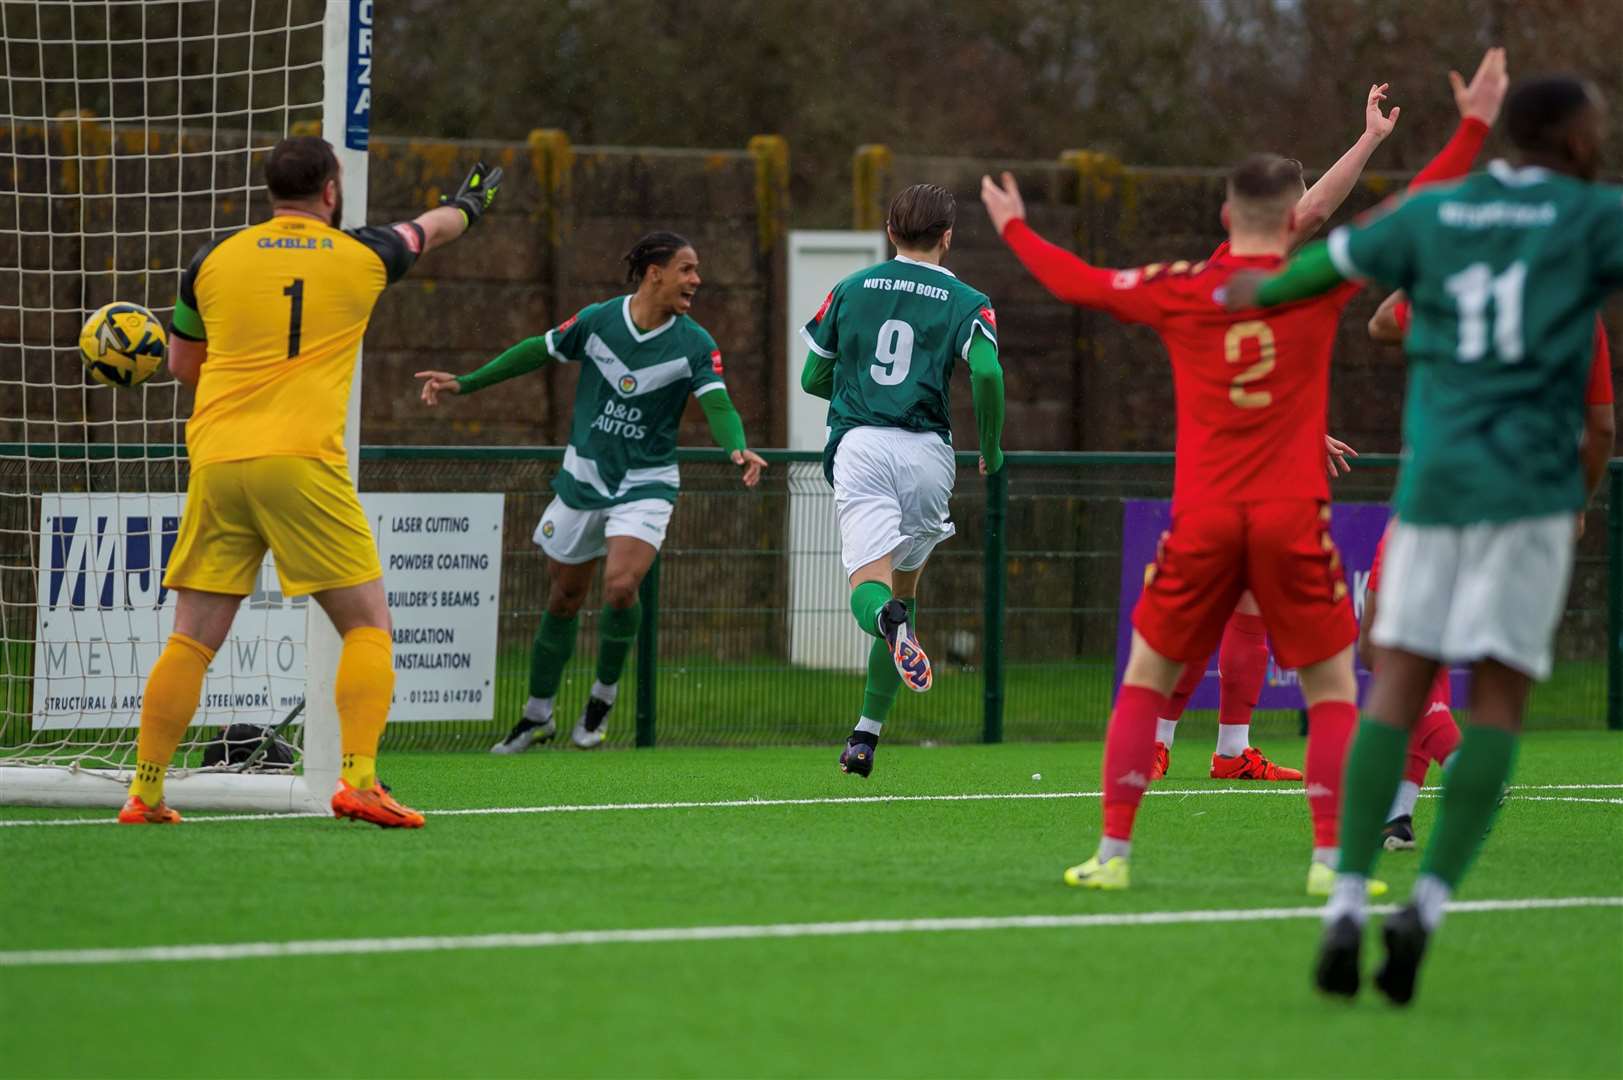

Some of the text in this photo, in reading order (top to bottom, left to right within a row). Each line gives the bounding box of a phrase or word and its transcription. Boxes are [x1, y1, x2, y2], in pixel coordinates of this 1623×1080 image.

[354, 0, 373, 115] ORZA
[863, 278, 950, 302] NUTS AND BOLTS
[283, 278, 304, 359] 1
[1444, 261, 1527, 363] 11
[870, 319, 914, 386] 9
[1224, 320, 1276, 409] 2
[604, 399, 643, 422] D&D
[591, 416, 648, 440] AUTOS
[391, 517, 470, 533] LASER CUTTING
[389, 553, 489, 570] POWDER COATING
[387, 591, 480, 608] BUILDER'S BEAMS
[391, 628, 455, 645] ABRICATION
[394, 653, 471, 670] INSTALLATION
[44, 695, 107, 711] STRUCTURAL
[206, 693, 269, 708] STEELWORK
[409, 689, 440, 704] 01233
[443, 689, 483, 704] 614780
